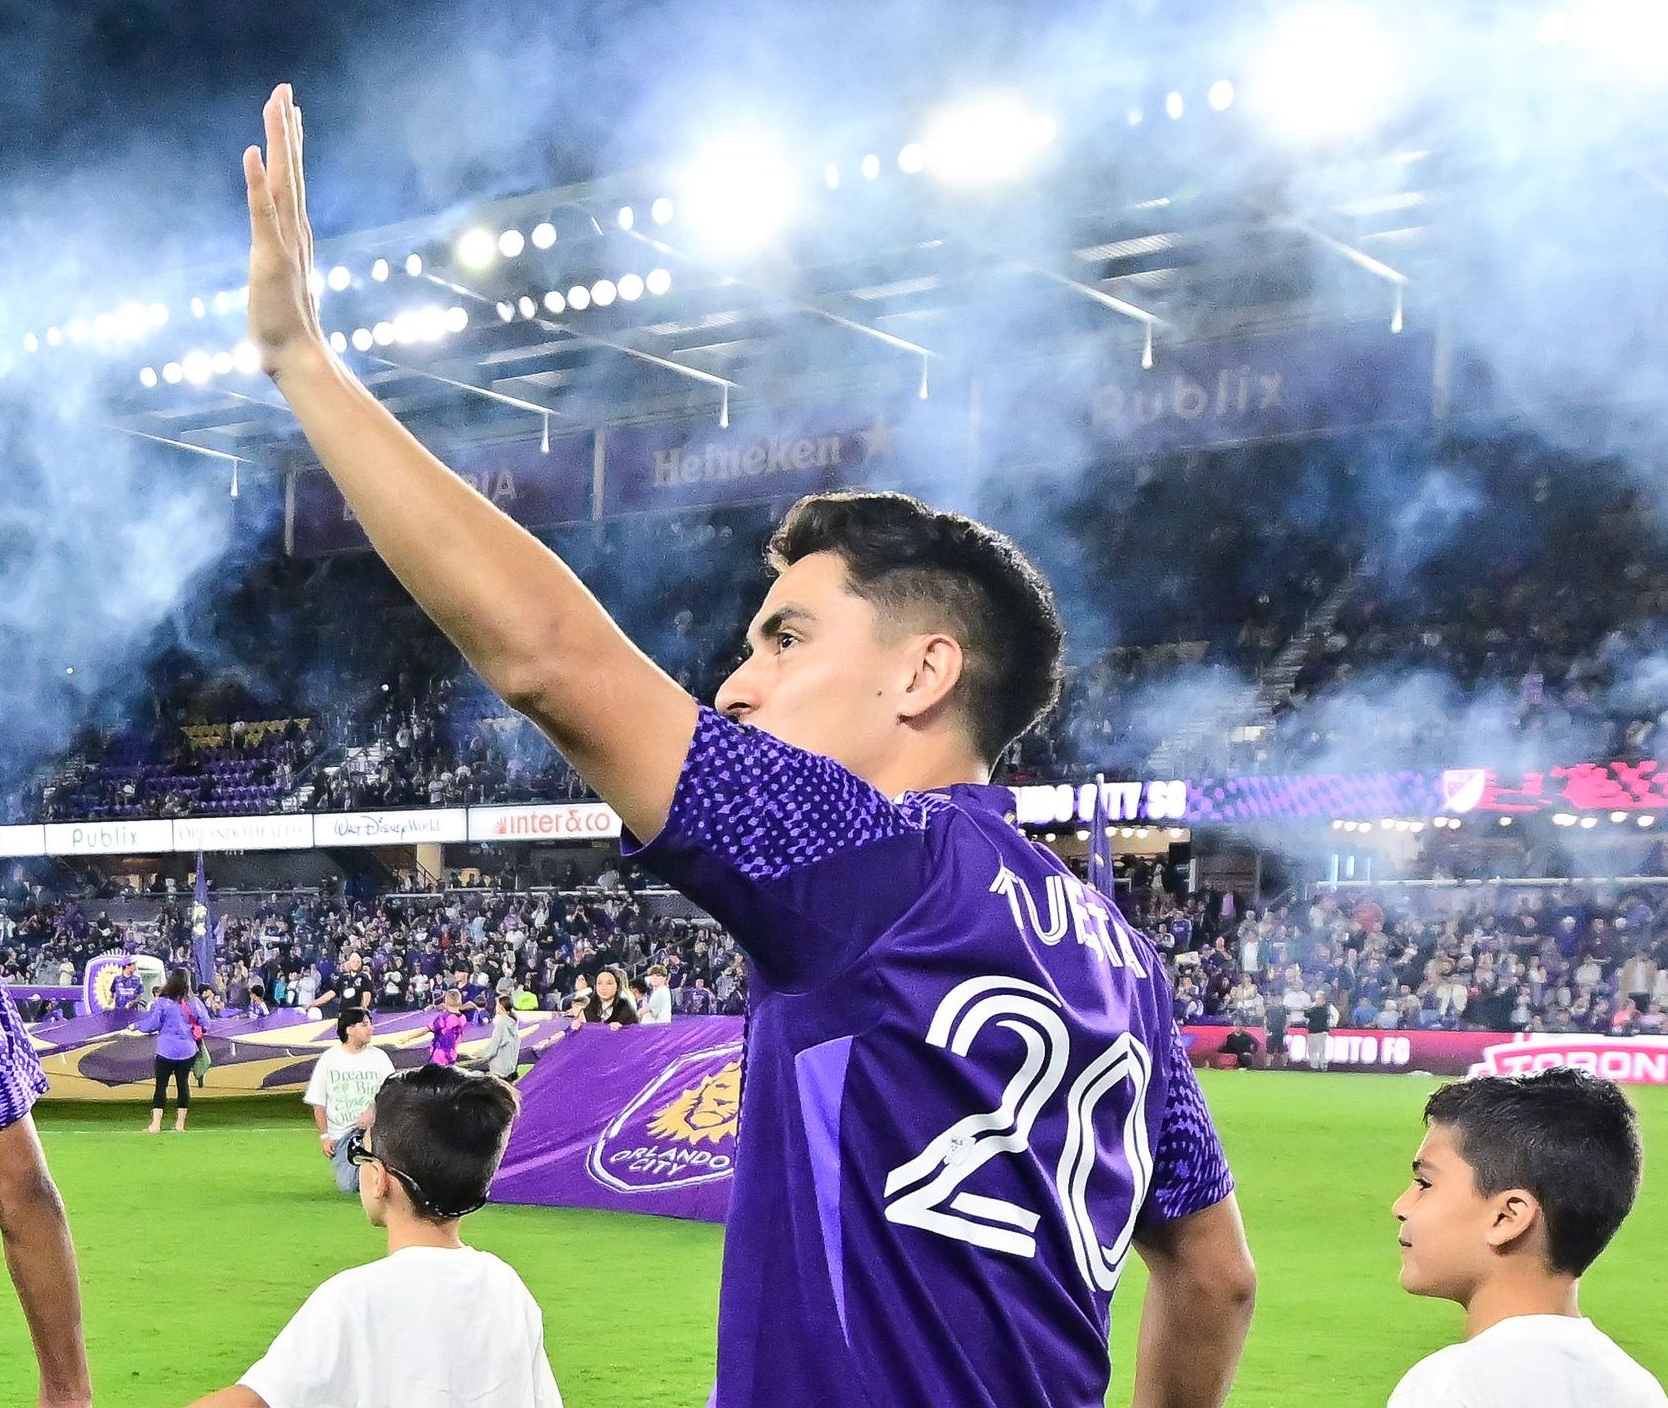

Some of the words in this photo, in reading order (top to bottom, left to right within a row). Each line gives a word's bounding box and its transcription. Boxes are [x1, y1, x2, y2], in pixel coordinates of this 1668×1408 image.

[653, 434, 843, 489] Heineken
[510, 806, 611, 834] inter&co
[72, 826, 137, 849] Publix
[330, 1069, 379, 1084] Dream
[883, 974, 1155, 1293] 20
[609, 1145, 731, 1168] ORLANDO
[629, 1158, 687, 1176] CITY
